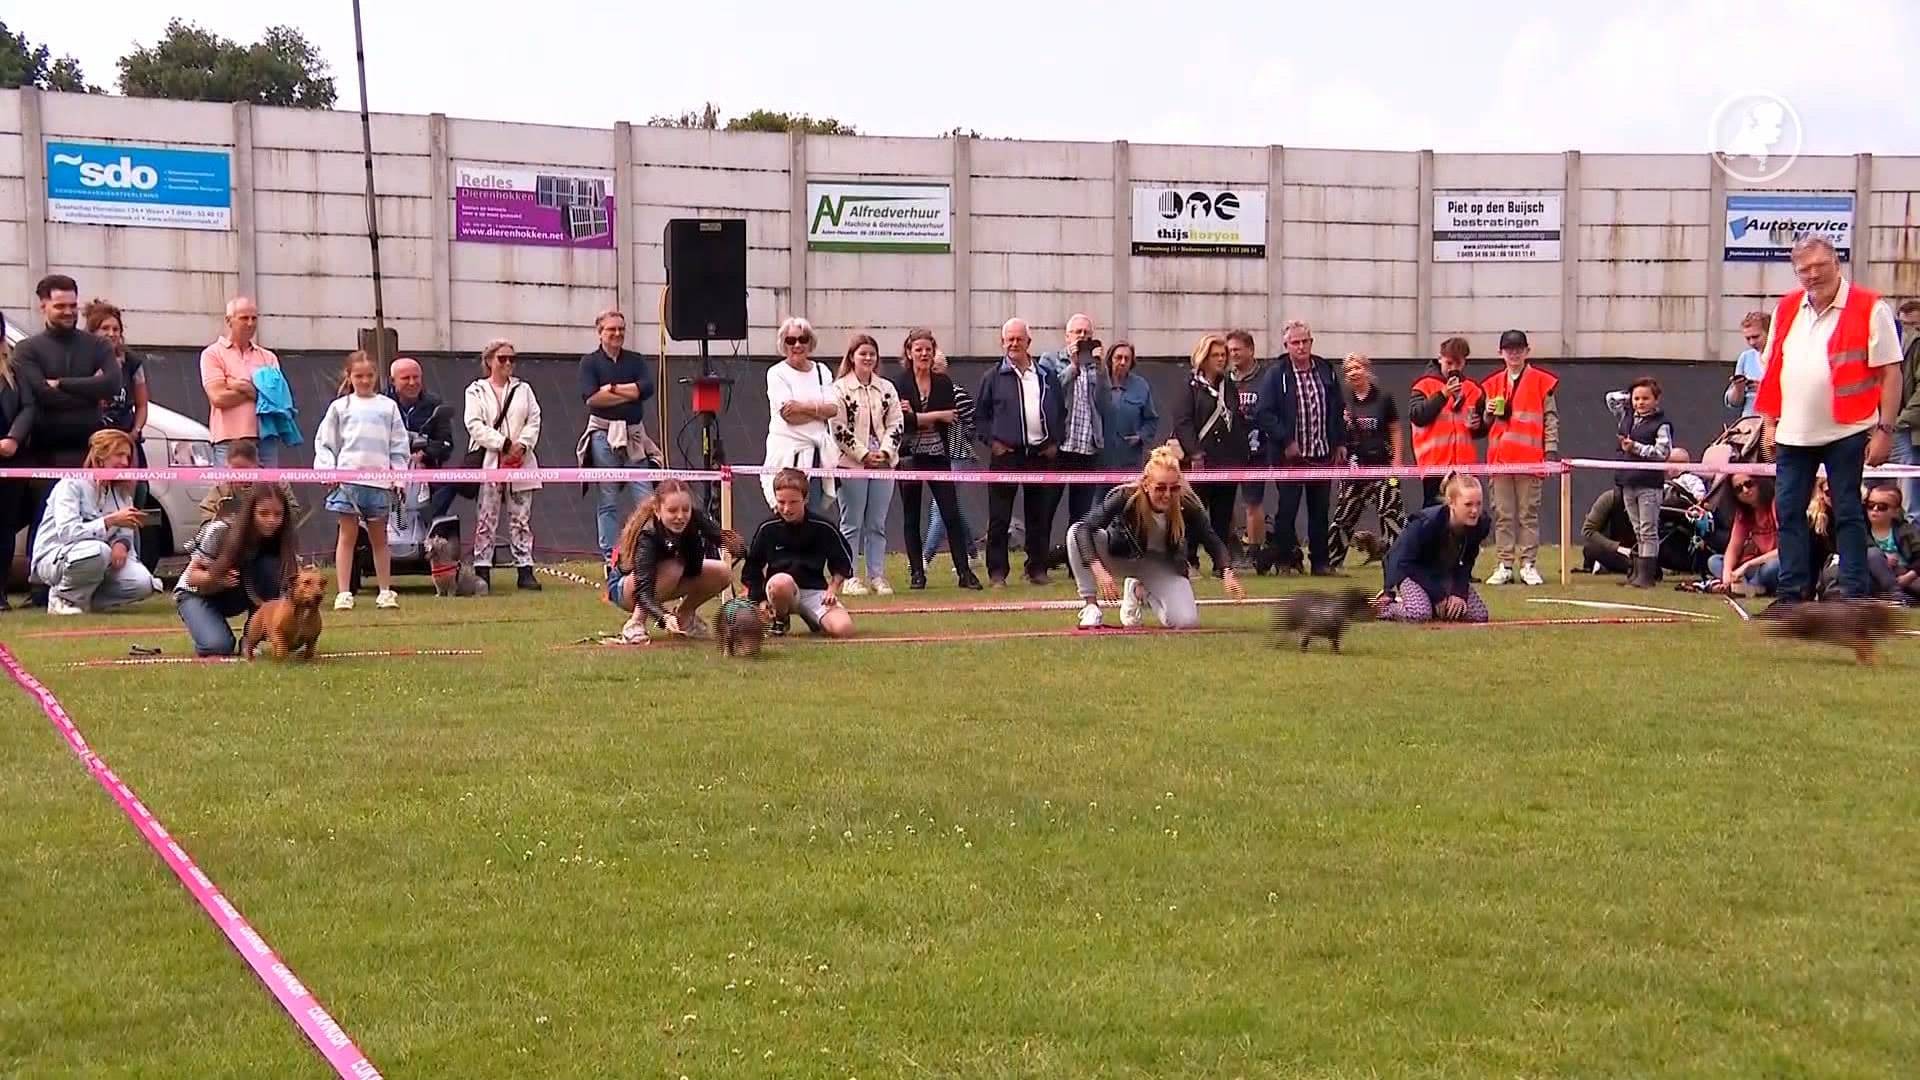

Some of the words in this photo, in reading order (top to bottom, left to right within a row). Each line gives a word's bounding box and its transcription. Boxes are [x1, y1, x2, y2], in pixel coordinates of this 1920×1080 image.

[461, 174, 513, 189] Redles
[461, 188, 534, 201] Dierenhokken
[850, 205, 941, 219] Alfredverhuur
[1447, 201, 1468, 213] Piet
[1471, 203, 1483, 215] op
[1486, 201, 1504, 213] den
[1508, 201, 1544, 215] Buijsch
[1453, 217, 1539, 228] bestratingen
[1745, 218, 1848, 231] Autoservice
[461, 227, 564, 241] www.dierenhokken.net
